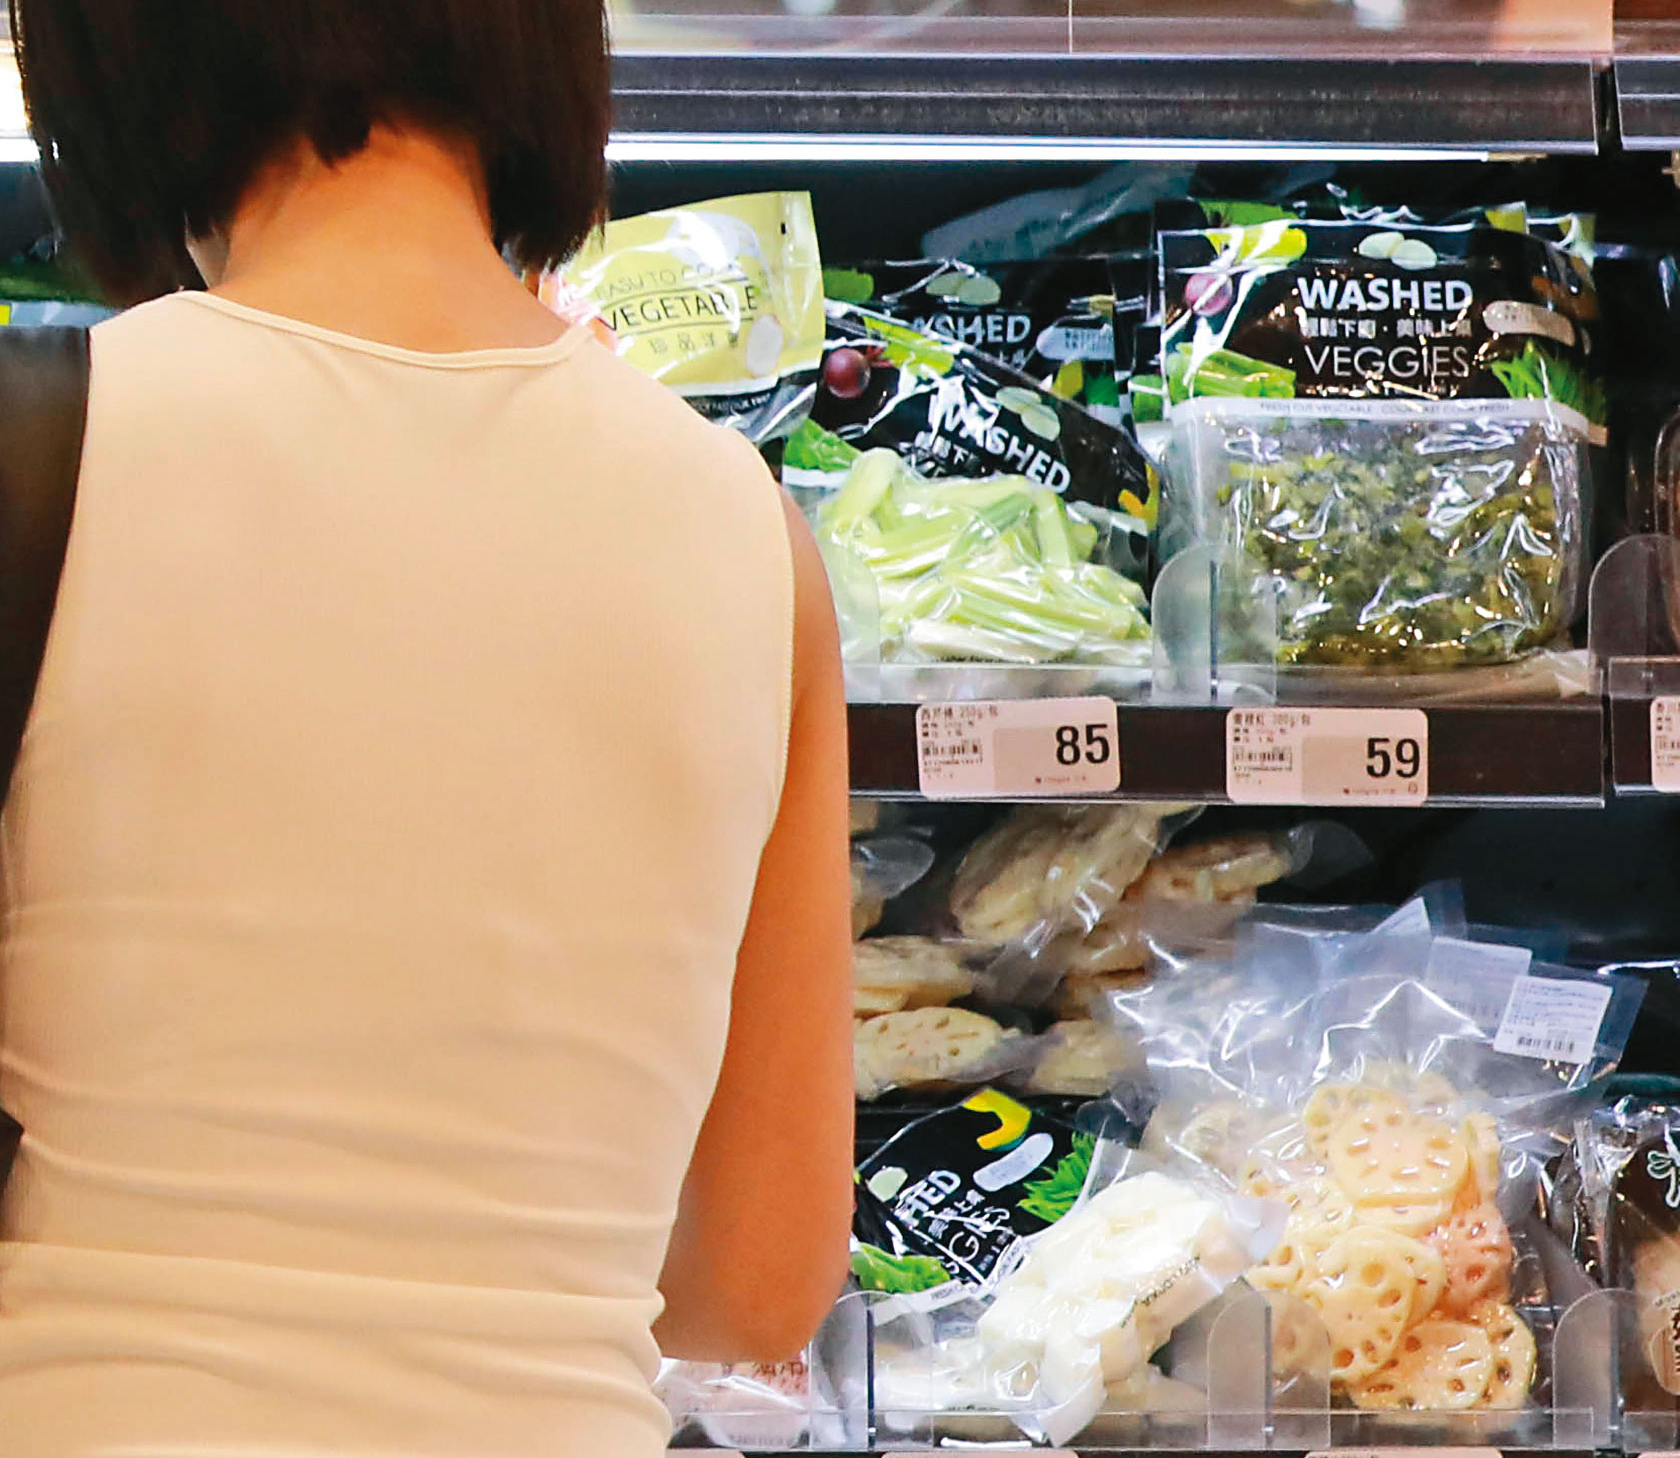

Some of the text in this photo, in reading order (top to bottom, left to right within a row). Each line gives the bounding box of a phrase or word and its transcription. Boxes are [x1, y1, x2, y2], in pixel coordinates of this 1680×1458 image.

[605, 288, 757, 333] VEGETABLE
[1297, 277, 1473, 311] WASHED
[1305, 344, 1469, 378] VEGGIES
[1056, 724, 1109, 765] 85
[1367, 738, 1419, 778] 59
